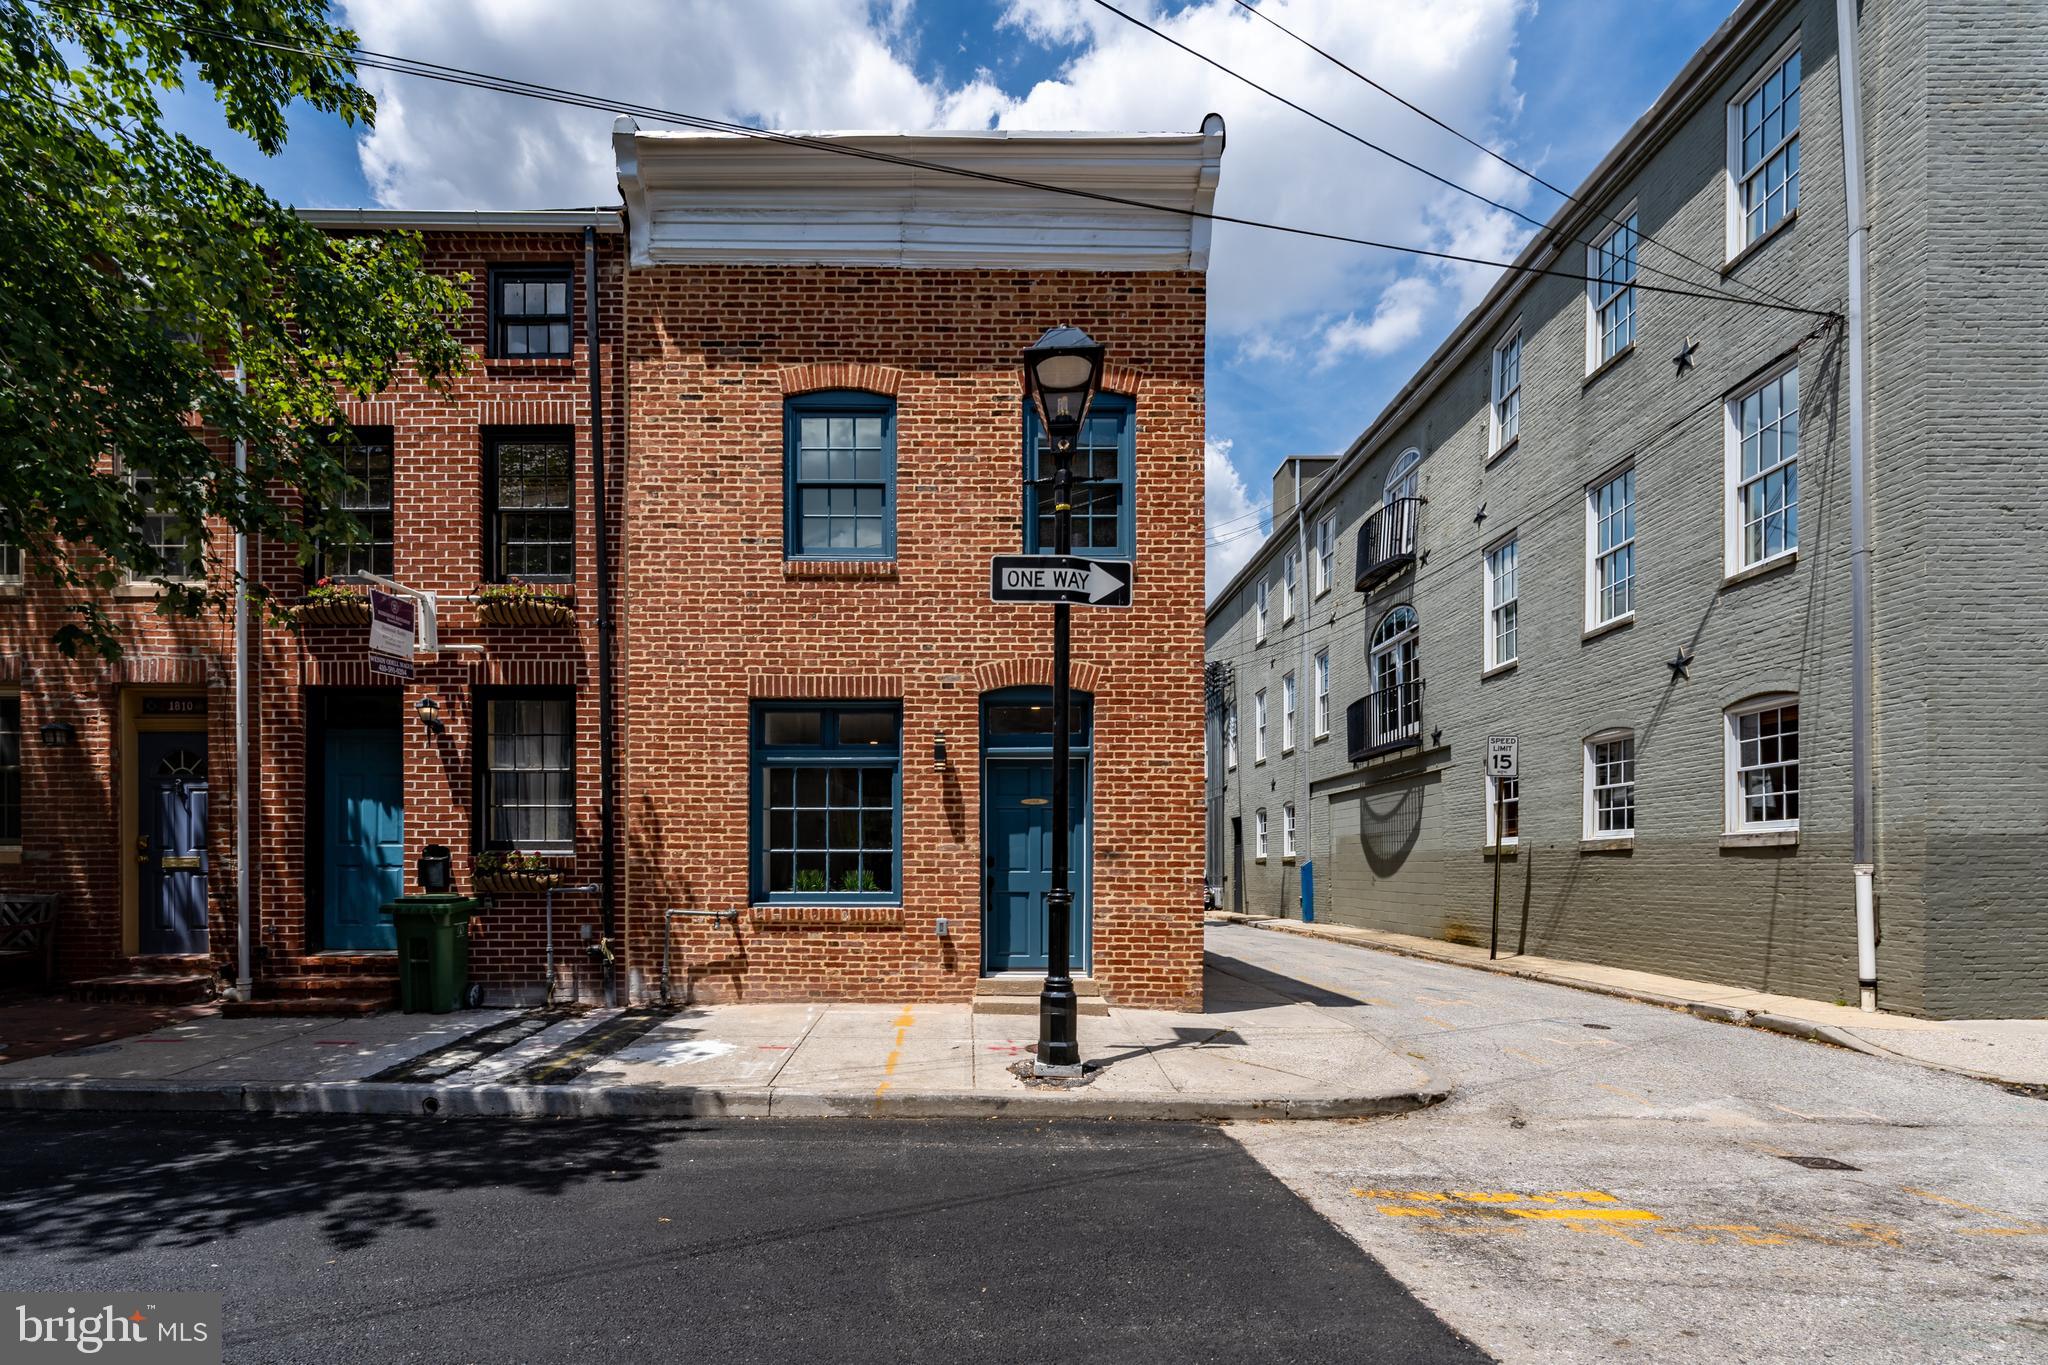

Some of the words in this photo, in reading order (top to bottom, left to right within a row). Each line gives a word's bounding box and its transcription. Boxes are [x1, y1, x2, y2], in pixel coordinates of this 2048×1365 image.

[1007, 570, 1045, 588] ONE
[1053, 570, 1090, 590] WAY
[168, 700, 193, 711] 1810
[1490, 737, 1516, 745] SPEED
[1492, 754, 1512, 769] 15
